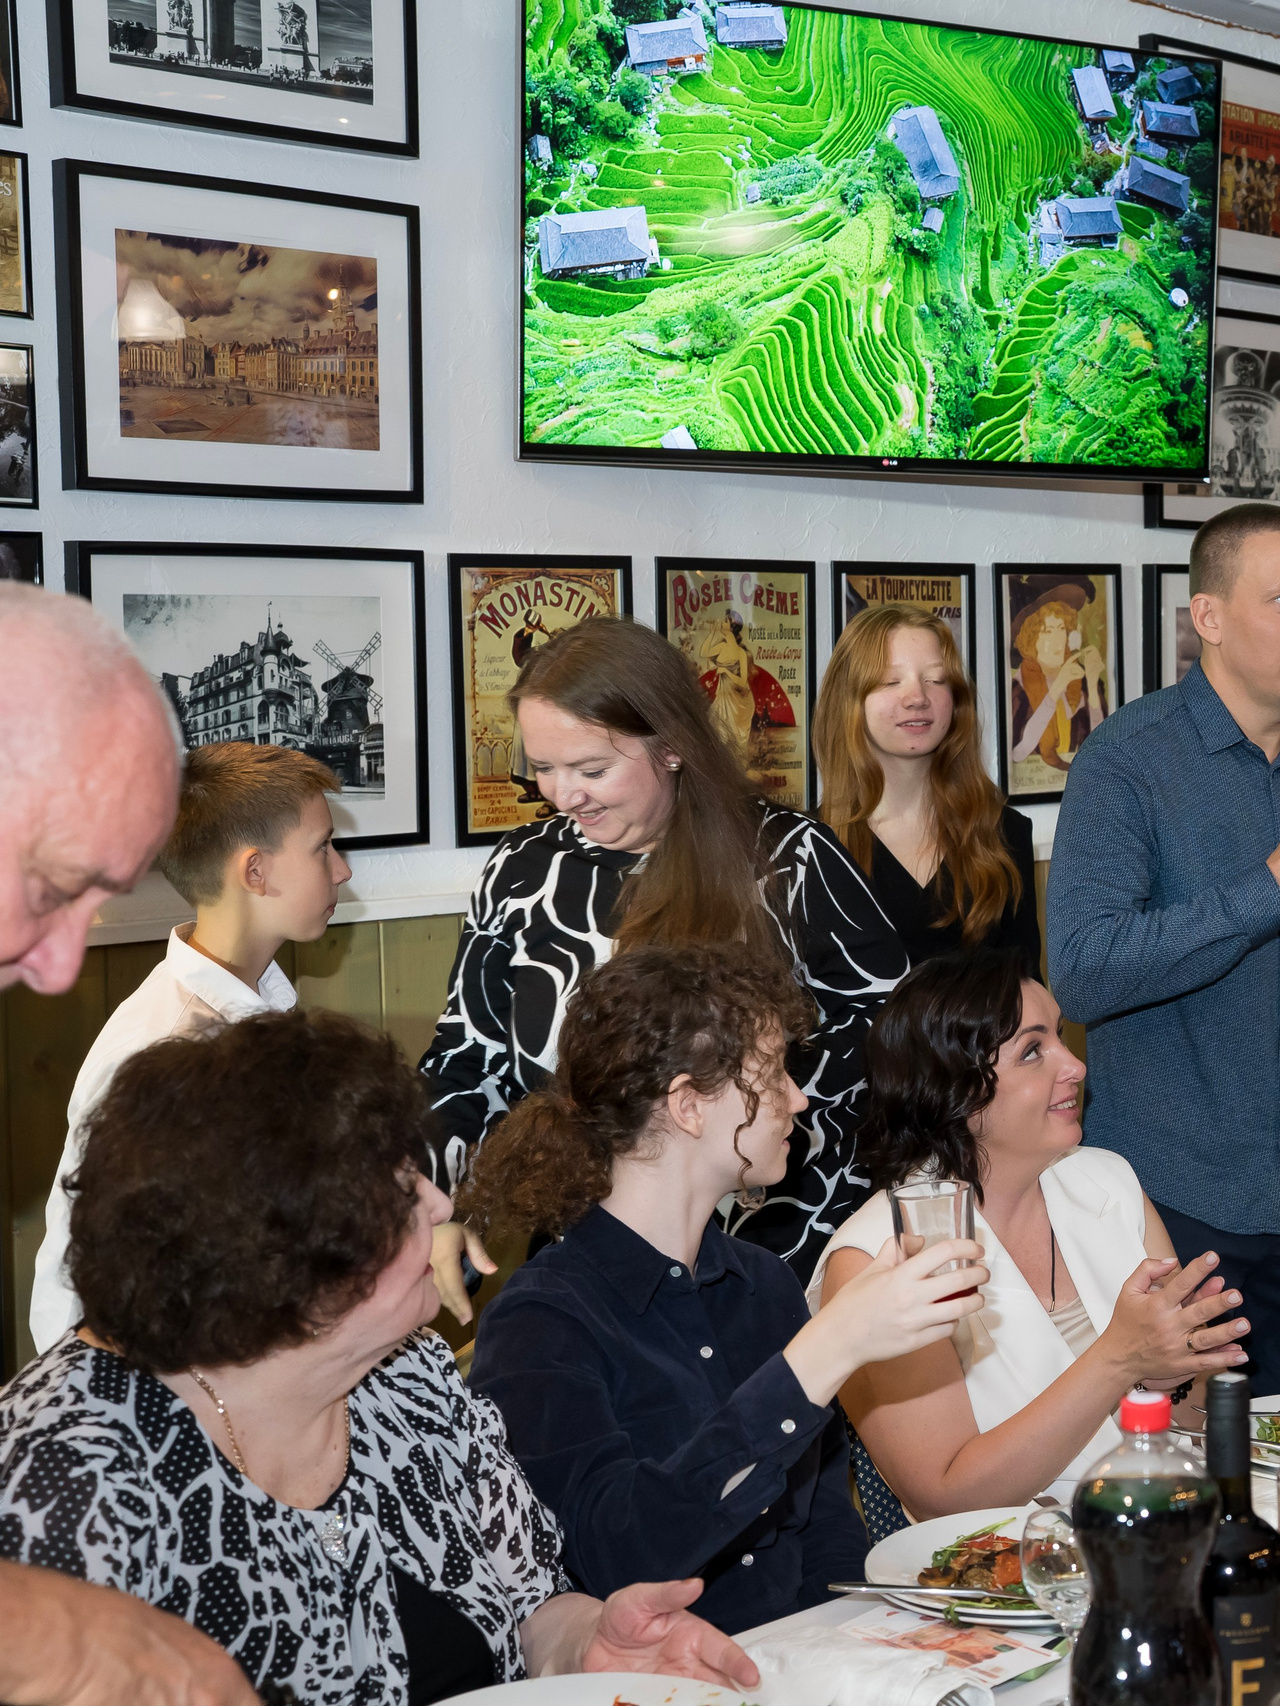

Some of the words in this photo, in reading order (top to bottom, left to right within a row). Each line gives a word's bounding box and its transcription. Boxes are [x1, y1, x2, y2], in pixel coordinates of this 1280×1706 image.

[672, 574, 735, 629] ROSÉE
[866, 578, 878, 600] LA
[879, 576, 952, 605] TOURICYCLETTE
[485, 816, 508, 825] PARIS
[1231, 1657, 1265, 1706] F
